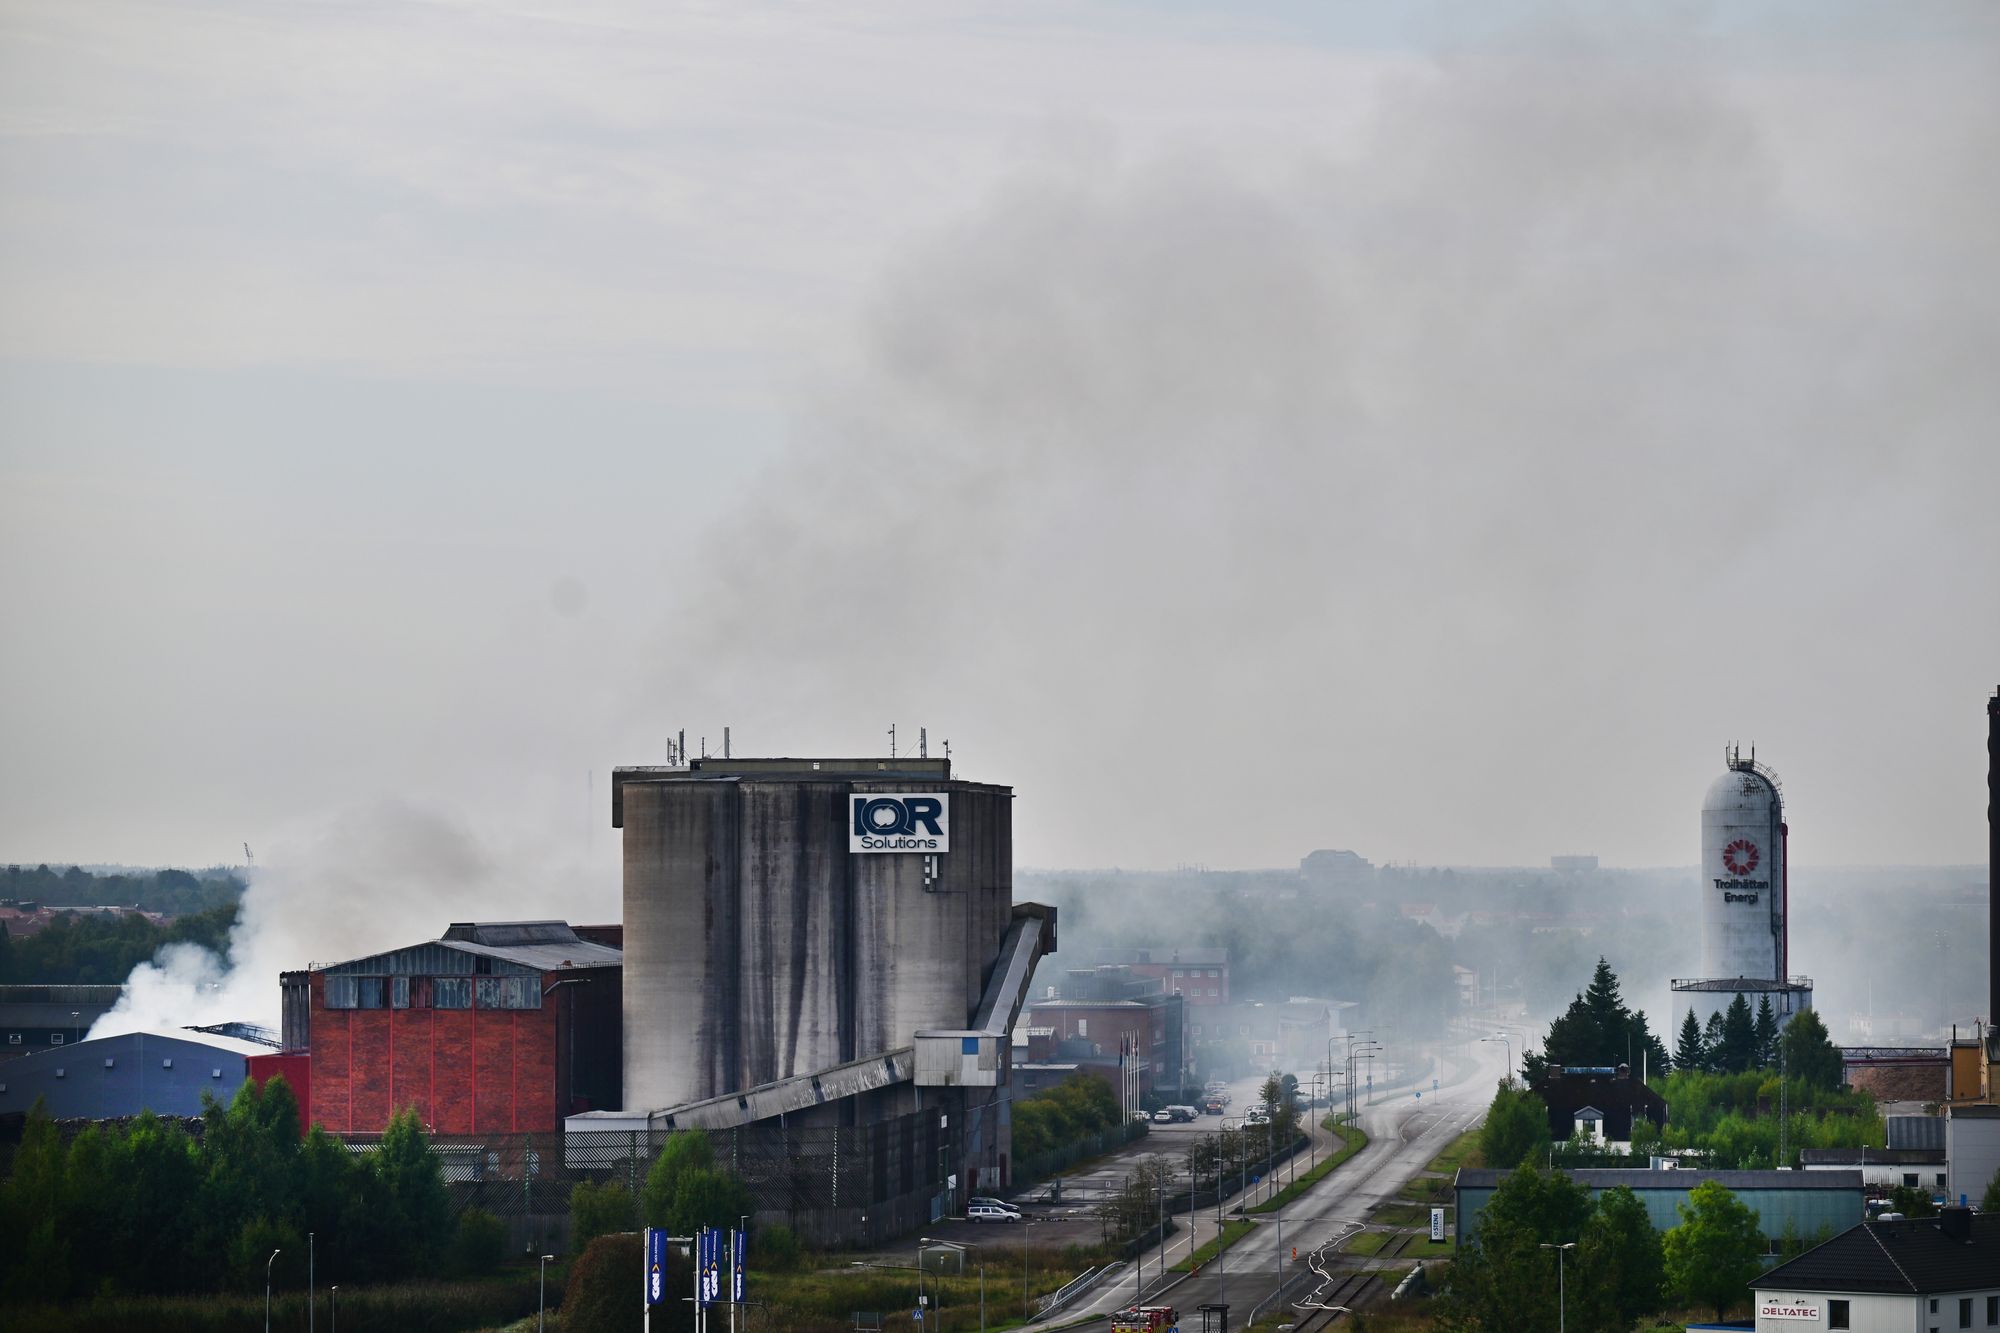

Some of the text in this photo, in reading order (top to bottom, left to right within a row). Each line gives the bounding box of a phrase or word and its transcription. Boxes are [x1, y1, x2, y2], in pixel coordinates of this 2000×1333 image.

[854, 798, 944, 836] IQR
[861, 836, 937, 849] Solutions
[1713, 878, 1769, 889] Trollhättan
[1724, 892, 1759, 904] Energi
[1762, 1307, 1817, 1317] DELTATEC
